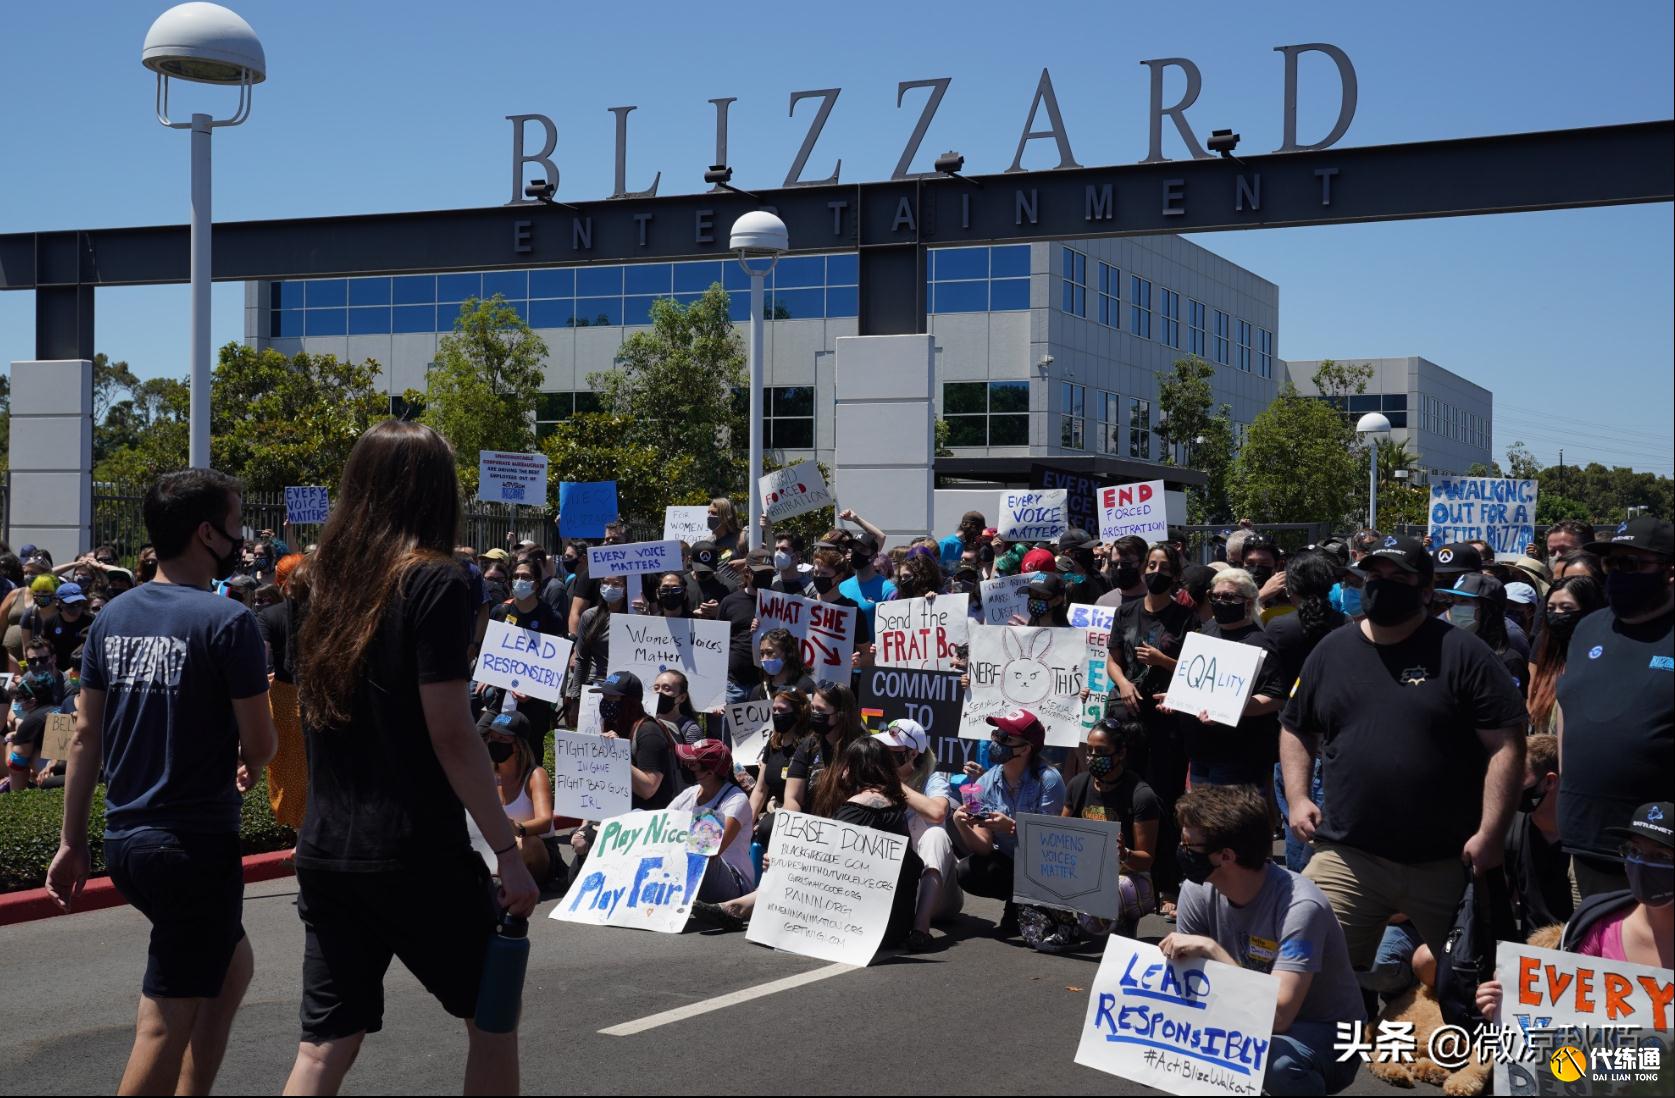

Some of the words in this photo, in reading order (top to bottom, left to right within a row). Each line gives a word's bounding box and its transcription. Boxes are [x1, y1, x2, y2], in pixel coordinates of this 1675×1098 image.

[505, 42, 1358, 206] BLIZZARD
[513, 168, 1339, 253] ENTETAINMENT
[286, 487, 327, 500] EVERY
[765, 482, 807, 506] FORCED
[1043, 470, 1100, 497] EVERY
[287, 498, 328, 511] VOICE
[1008, 494, 1042, 509] EVERY
[1103, 484, 1153, 509] END
[1013, 507, 1061, 523] VOICE
[1106, 504, 1152, 522] FORCED
[1431, 502, 1475, 524] OUT
[1480, 503, 1509, 524] FOR
[1513, 504, 1528, 523] A
[1008, 525, 1066, 539] MATTERS
[1102, 520, 1166, 539] ARBITRATION
[592, 550, 627, 563] EVERY
[635, 546, 666, 558] VOICE
[610, 559, 661, 572] MATTERS
[759, 592, 804, 625] WHAT
[809, 605, 848, 634] SHE
[877, 602, 911, 634] Send
[920, 600, 948, 628] the
[501, 633, 556, 659] LEAD
[690, 632, 723, 653] Voices
[882, 628, 931, 663] FRAT
[1090, 648, 1106, 658] TO
[634, 648, 681, 663] Matter
[482, 653, 563, 689] RESPONSIBLY
[969, 661, 1001, 685] NERF
[1051, 666, 1084, 697] THIS
[1178, 654, 1246, 697] EQALITY
[872, 670, 961, 702] COMMIT
[904, 702, 934, 731] TO
[557, 739, 590, 758] FIGHT
[591, 743, 609, 758] BAD
[610, 747, 630, 761] GUYS
[577, 760, 588, 772] IN
[589, 761, 610, 774] GAME
[557, 774, 584, 791] FIGHT
[587, 778, 606, 792] BAD
[608, 782, 629, 798] GUYS
[580, 794, 602, 810] IRL
[596, 820, 645, 858] Play
[643, 813, 689, 846] Nice
[775, 811, 838, 846] PLEASE
[840, 827, 903, 861] DONATE
[1040, 832, 1086, 853] WOMENS
[1041, 849, 1077, 866] VOICES
[1040, 863, 1079, 879] MATTER
[568, 871, 627, 920] Play
[626, 852, 710, 914] Fair!
[1119, 952, 1211, 997] LEAD
[1518, 956, 1674, 1033] EVERY
[1094, 992, 1269, 1071] RESPONSIBLY
